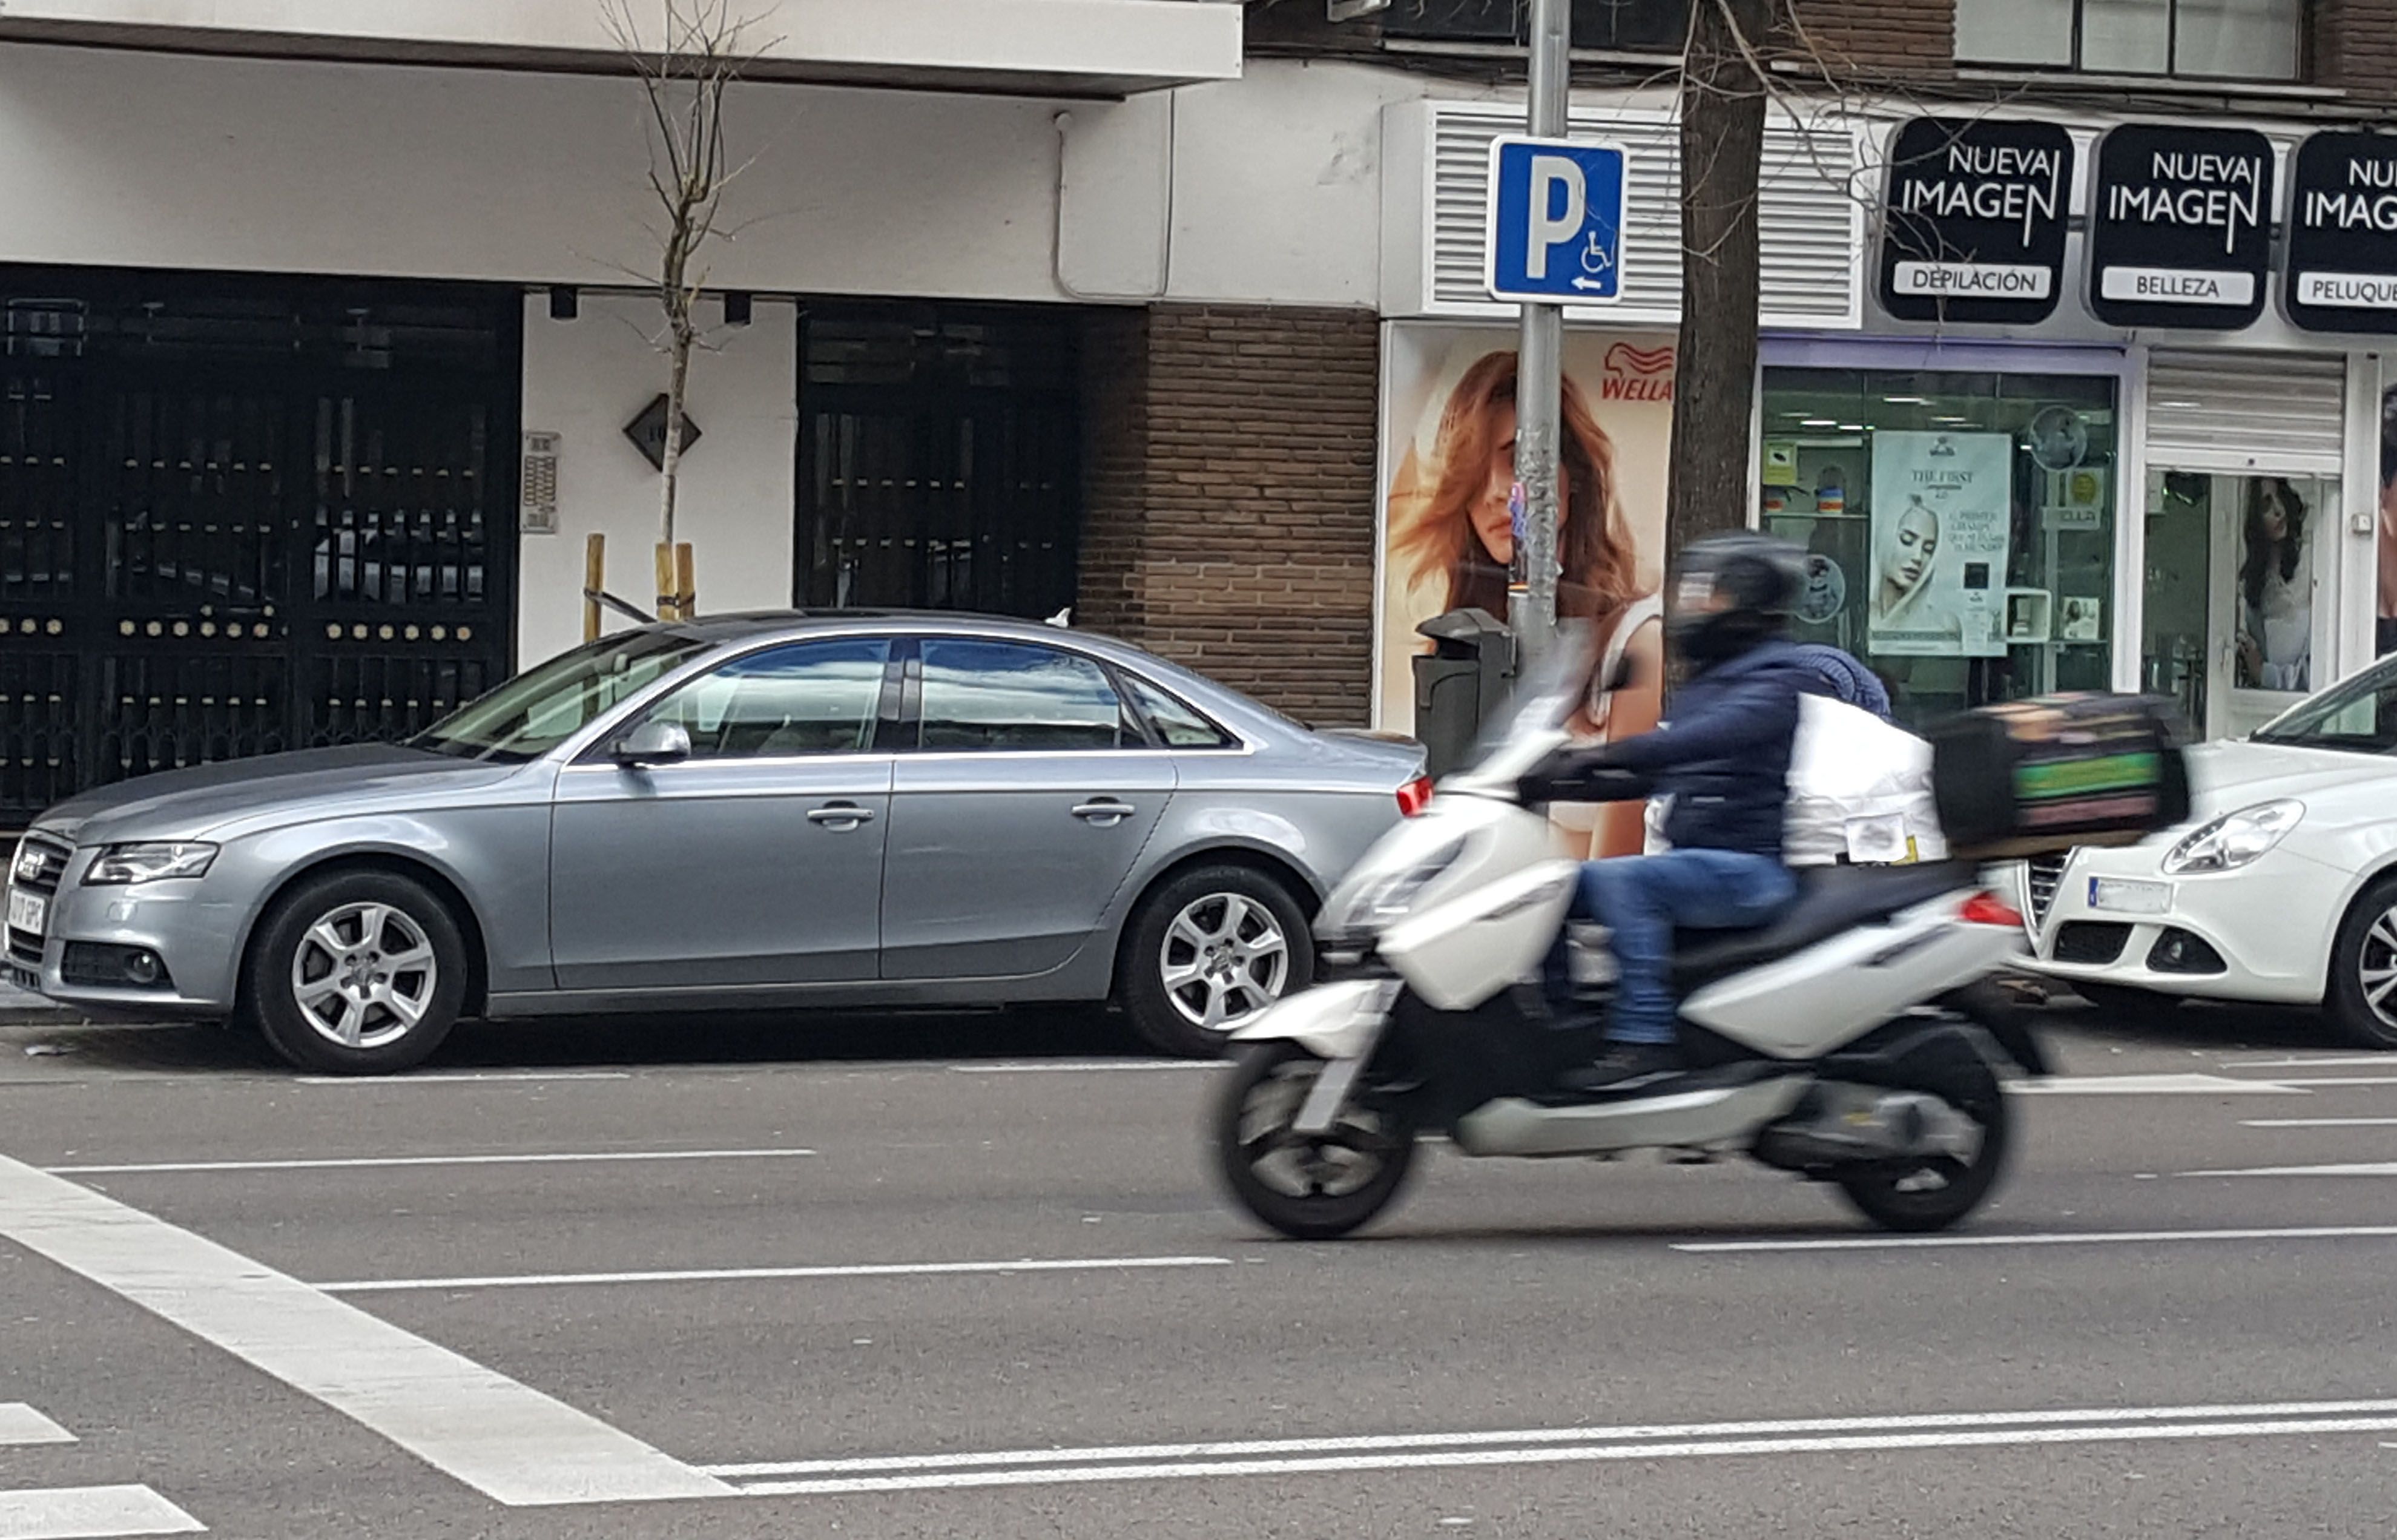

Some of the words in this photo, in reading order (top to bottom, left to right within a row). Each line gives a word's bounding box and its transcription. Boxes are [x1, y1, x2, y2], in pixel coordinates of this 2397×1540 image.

[1948, 145, 2051, 177] NUEVA
[2153, 152, 2252, 184] NUEVA
[2349, 159, 2397, 188] NU
[1902, 149, 2060, 247] IMAGEN
[2109, 157, 2261, 254] IMAGEN
[1526, 155, 1586, 279] P
[2137, 275, 2220, 298] BELLEZA
[1601, 378, 1673, 401] WELLA
